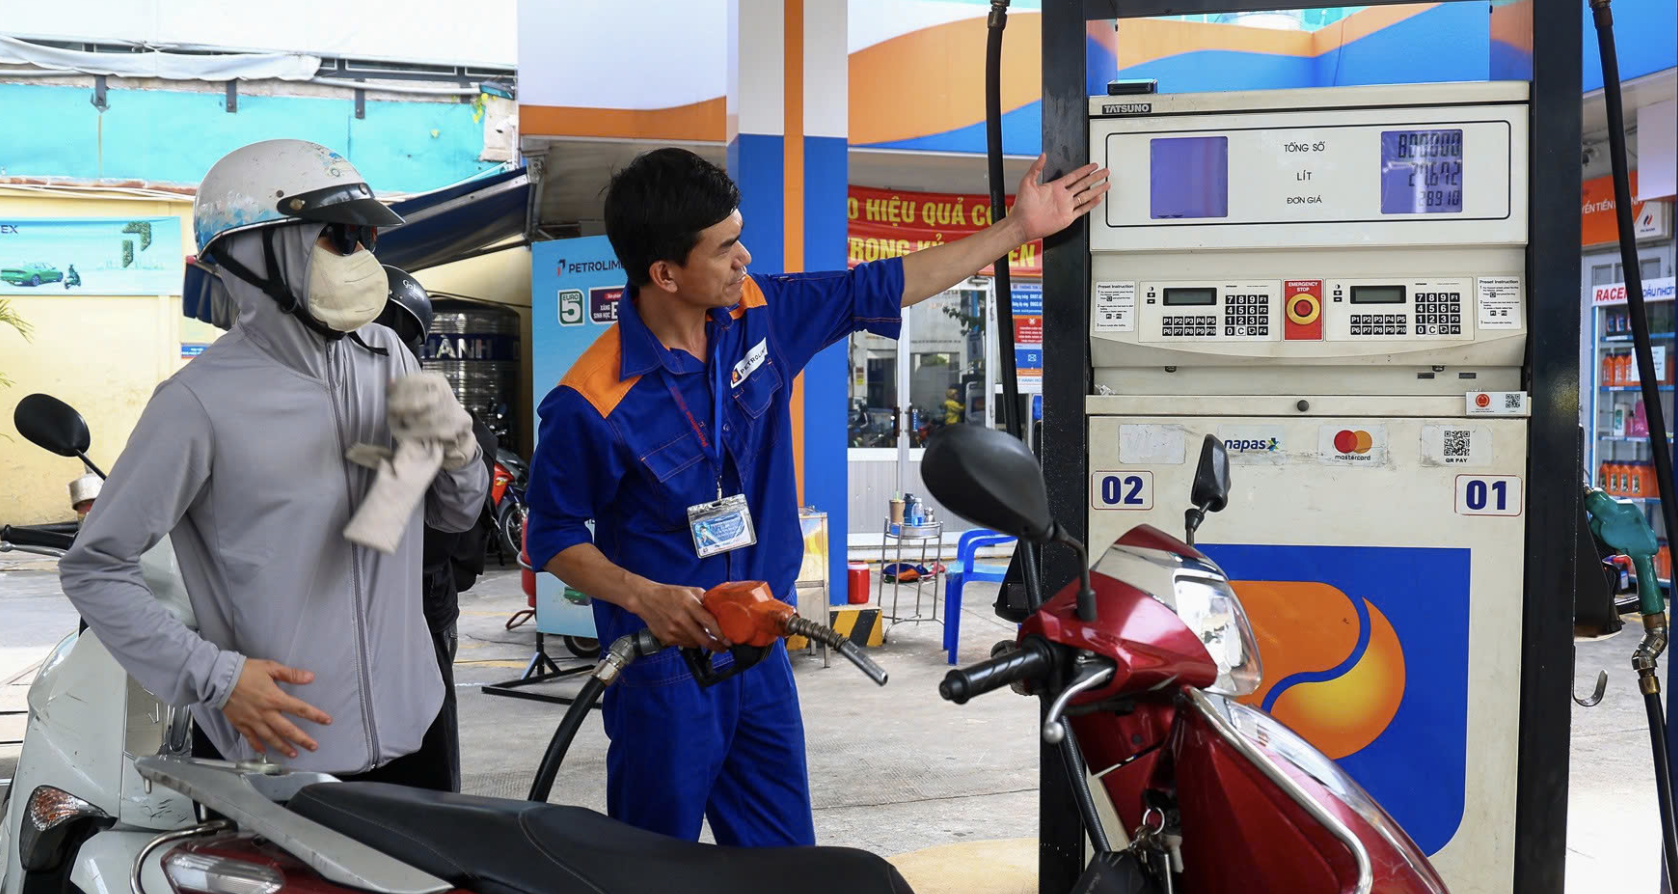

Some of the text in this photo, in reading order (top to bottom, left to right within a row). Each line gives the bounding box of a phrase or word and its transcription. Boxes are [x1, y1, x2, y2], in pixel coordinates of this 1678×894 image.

[1104, 104, 1150, 113] TATSUNO
[1312, 141, 1326, 152] SỐ
[1398, 132, 1461, 158] 800000
[1296, 169, 1312, 181] LÍT
[1286, 194, 1323, 204] ĐƠN GIÁ
[866, 195, 916, 227] HIỆU
[922, 197, 966, 227] QUẢ
[848, 237, 910, 262] RONG
[1228, 296, 1233, 304] 7
[1238, 296, 1244, 304] 8
[1249, 296, 1255, 304] 9
[1417, 294, 1423, 302] 7
[1428, 294, 1435, 302] 8
[1440, 294, 1446, 302] 9
[561, 300, 582, 323] 5
[1417, 304, 1424, 312] 4
[1429, 304, 1435, 312] 5
[1440, 304, 1447, 312] 6
[1238, 316, 1244, 324] 2
[1249, 316, 1255, 324] 3
[1418, 326, 1424, 334] 0
[1428, 326, 1436, 334] C
[1224, 438, 1266, 452] napas
[1102, 475, 1144, 505] 02
[1466, 480, 1507, 511] 01
